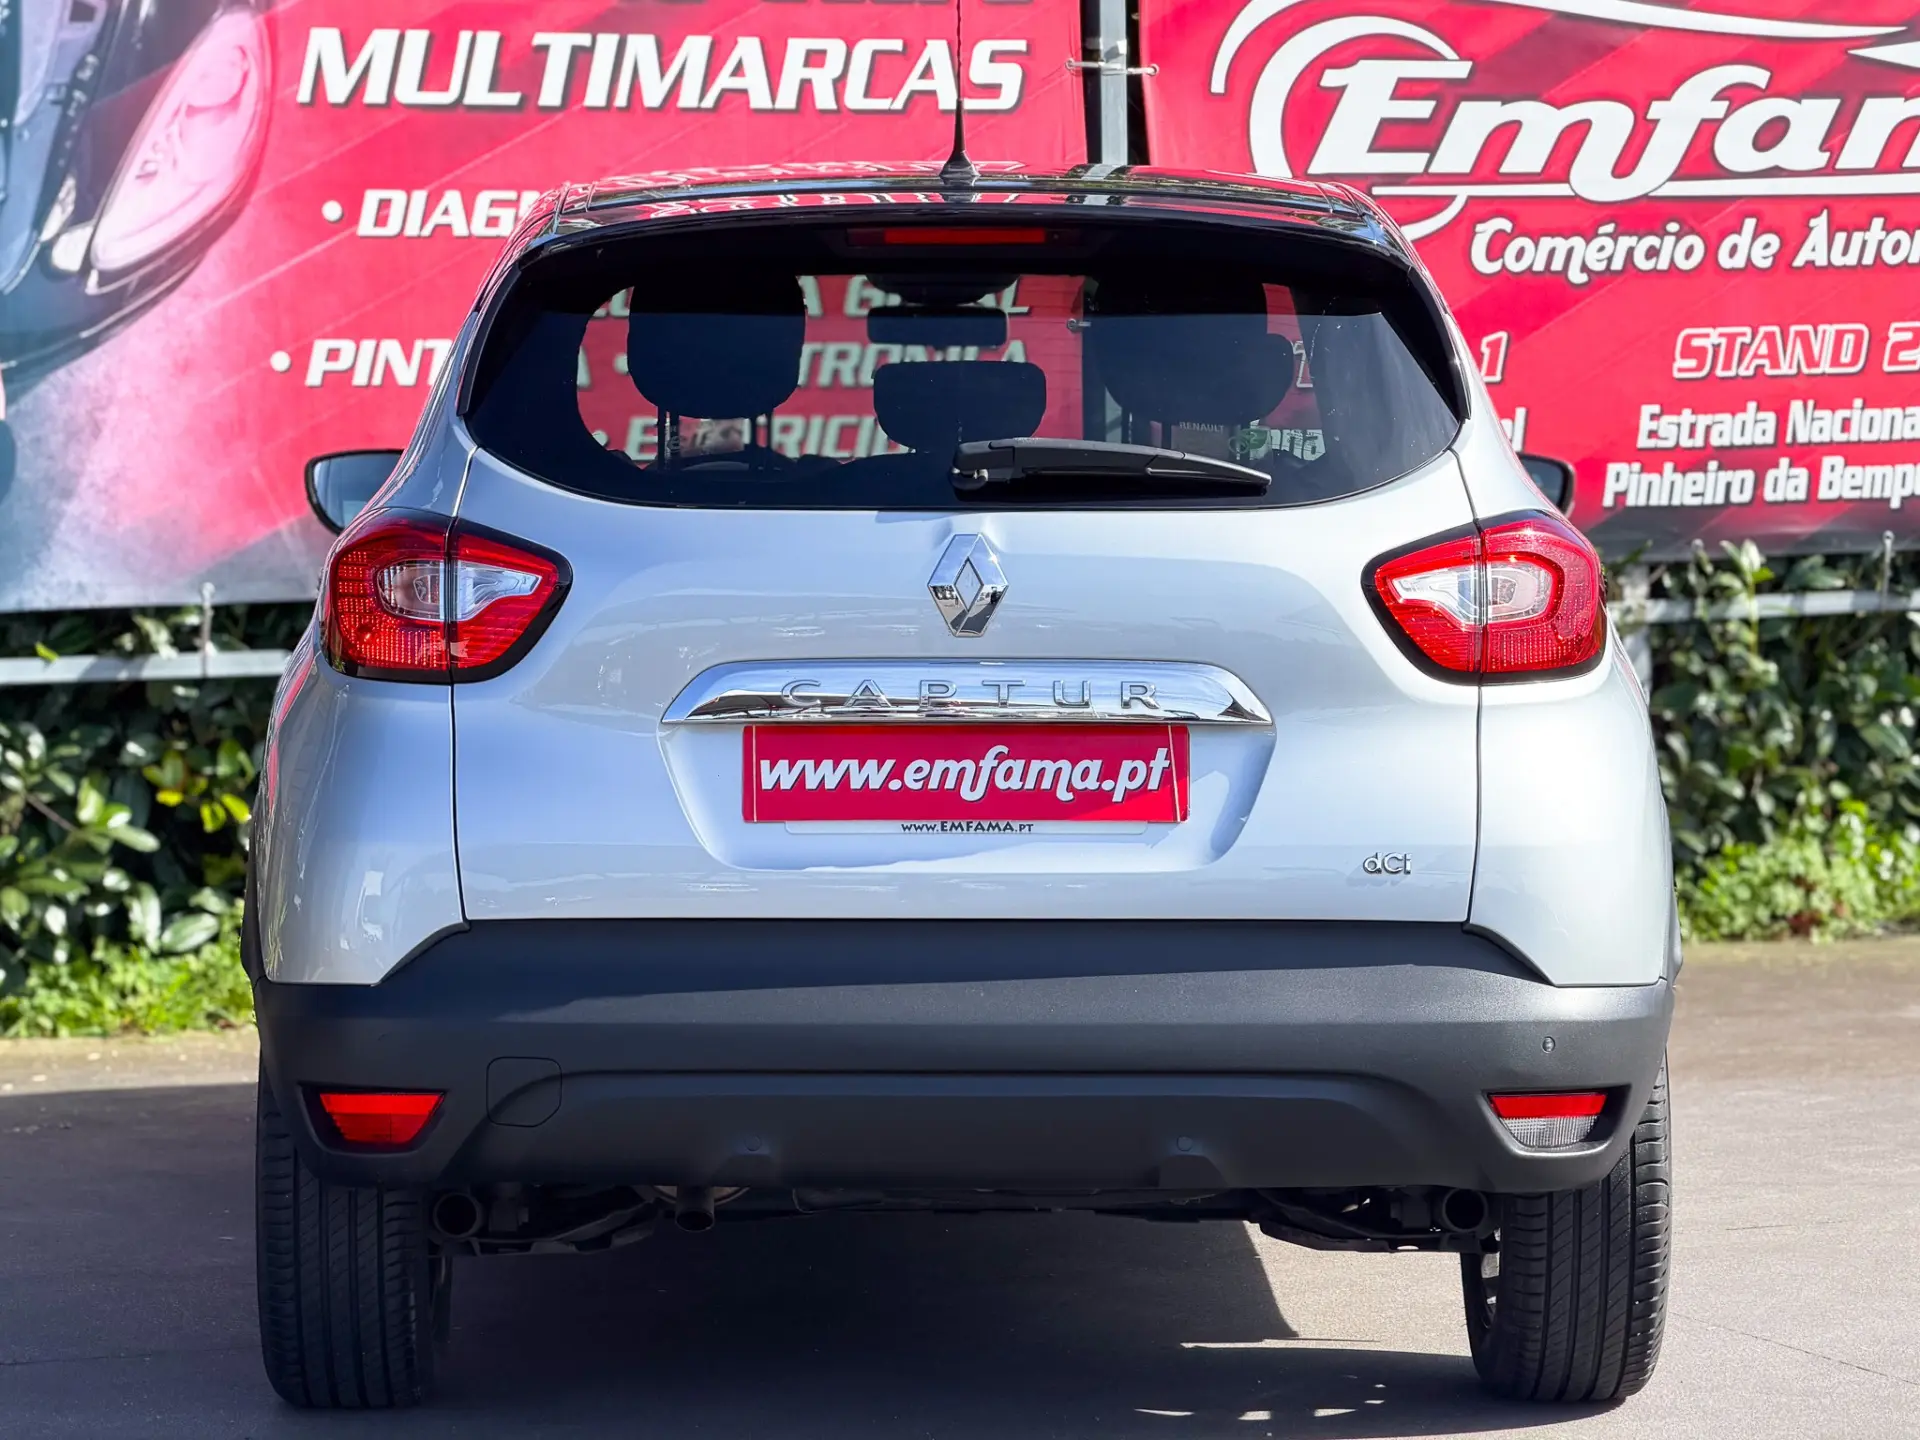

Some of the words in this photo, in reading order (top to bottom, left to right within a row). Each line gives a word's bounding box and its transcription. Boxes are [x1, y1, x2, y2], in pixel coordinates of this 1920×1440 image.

[297, 27, 1028, 111] MULTIMARCAS
[1470, 217, 1705, 284] Comércio
[1717, 217, 1781, 270] de
[1672, 323, 1869, 379] STAND
[1179, 421, 1225, 433] RENAULT
[1636, 400, 1777, 449] Estrada
[1602, 460, 1756, 508] Pinheiro
[1763, 456, 1808, 503] da
[1817, 454, 1920, 509] Bemp
[781, 679, 1160, 710] CAPTUR
[760, 744, 1170, 802] www.emfama.pt
